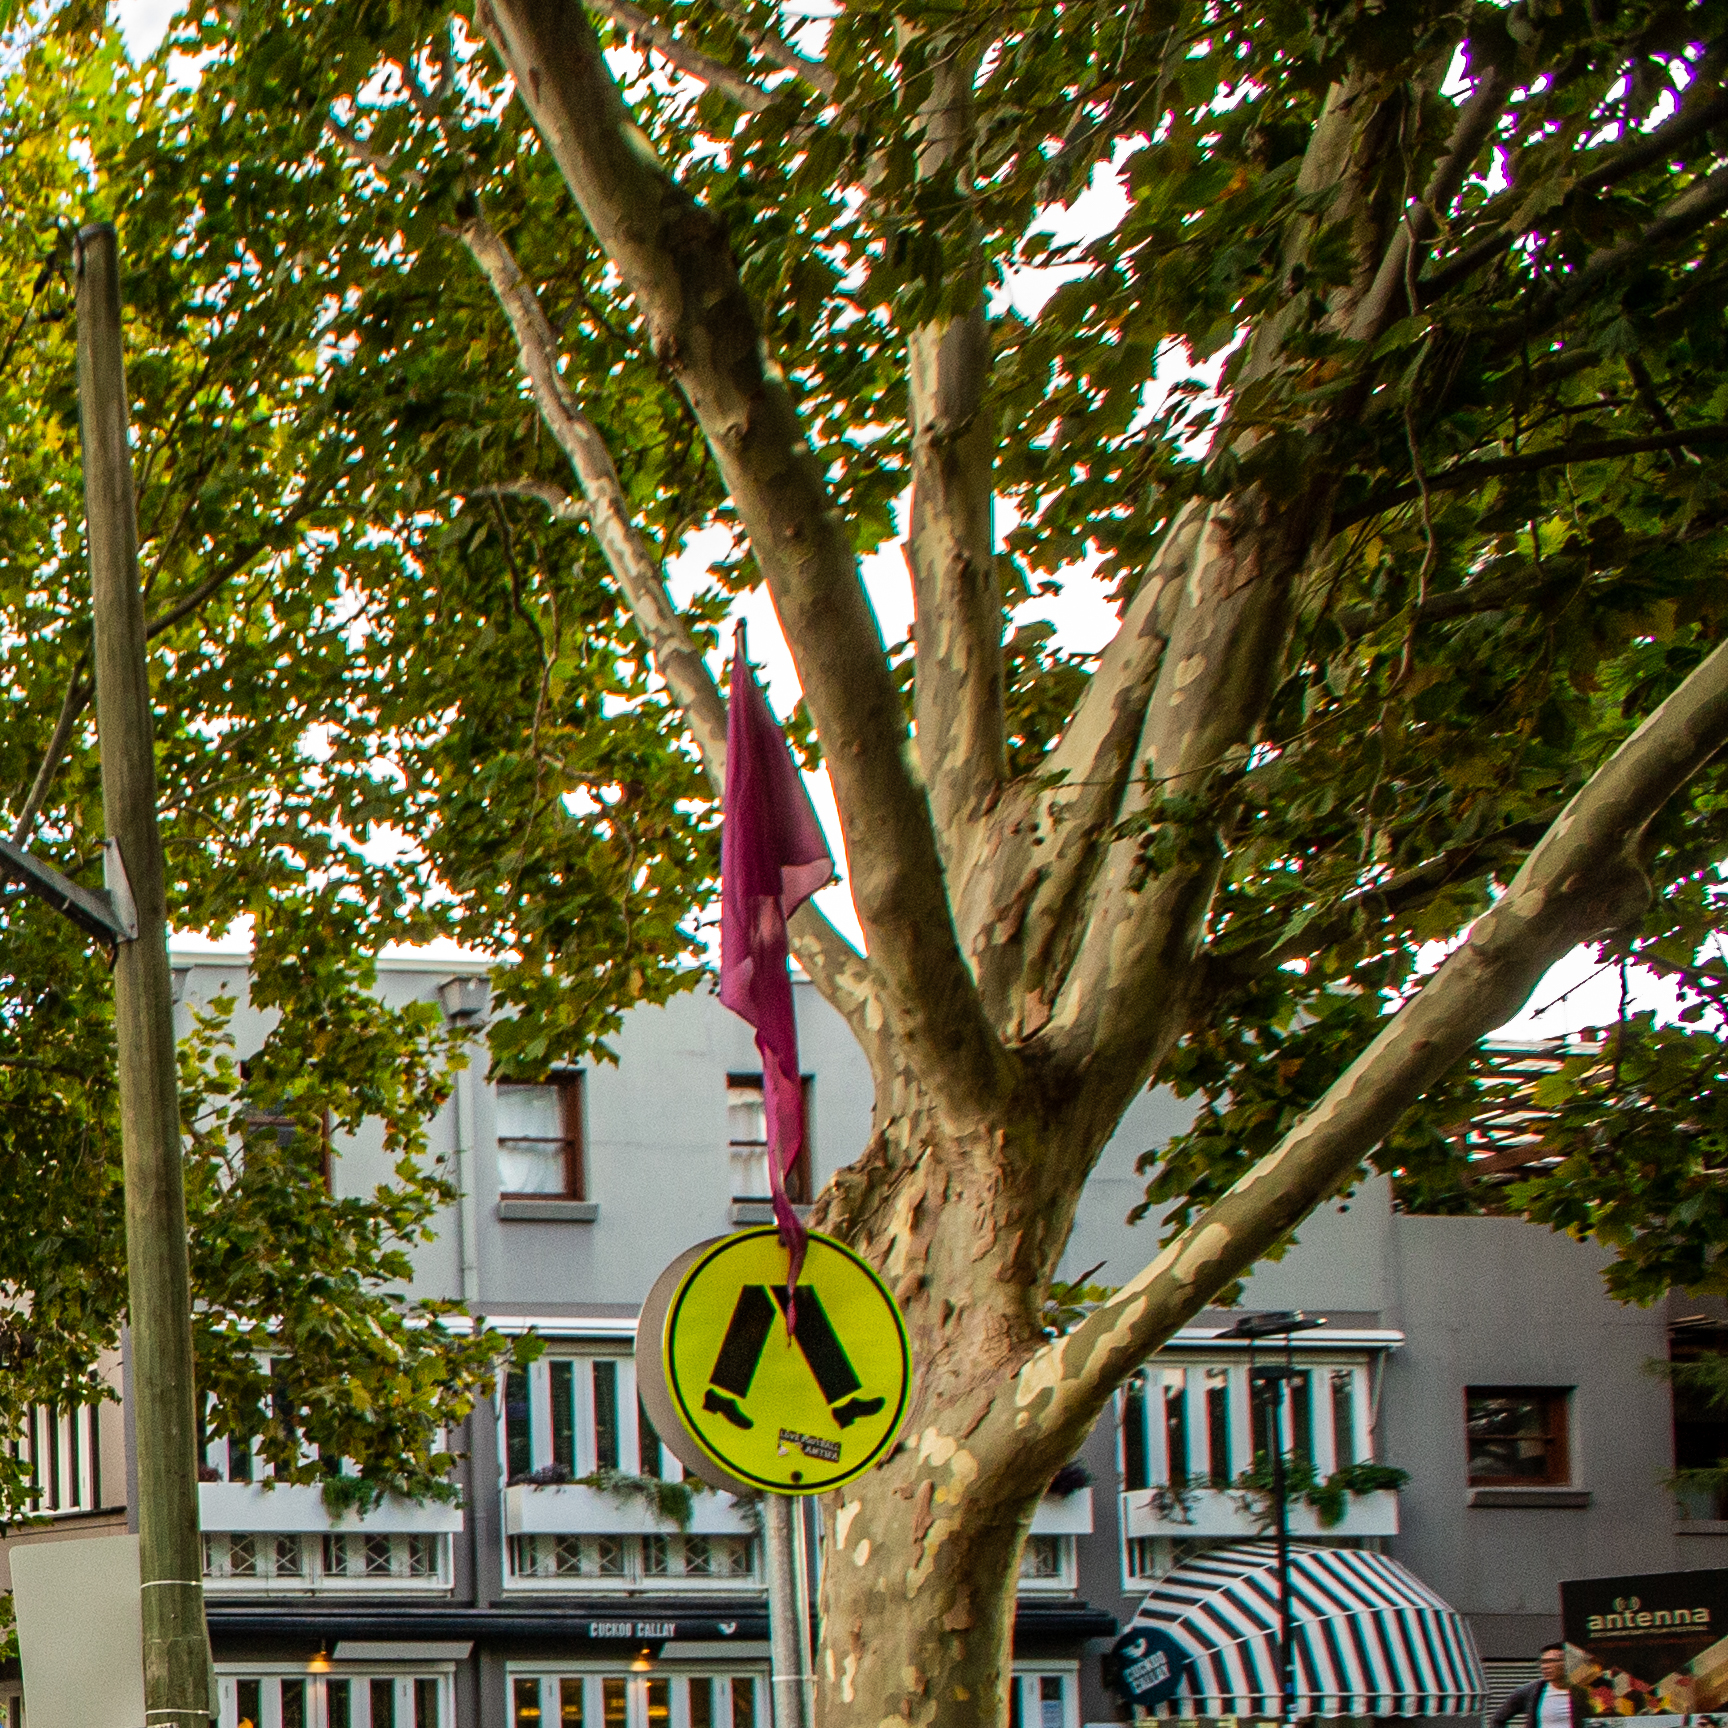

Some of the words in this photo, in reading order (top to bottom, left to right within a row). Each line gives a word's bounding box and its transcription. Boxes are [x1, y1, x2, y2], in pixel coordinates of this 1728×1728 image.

[1587, 1607, 1711, 1630] antenna
[589, 1622, 633, 1637] CUCKOO
[636, 1622, 676, 1637] CALLAY
